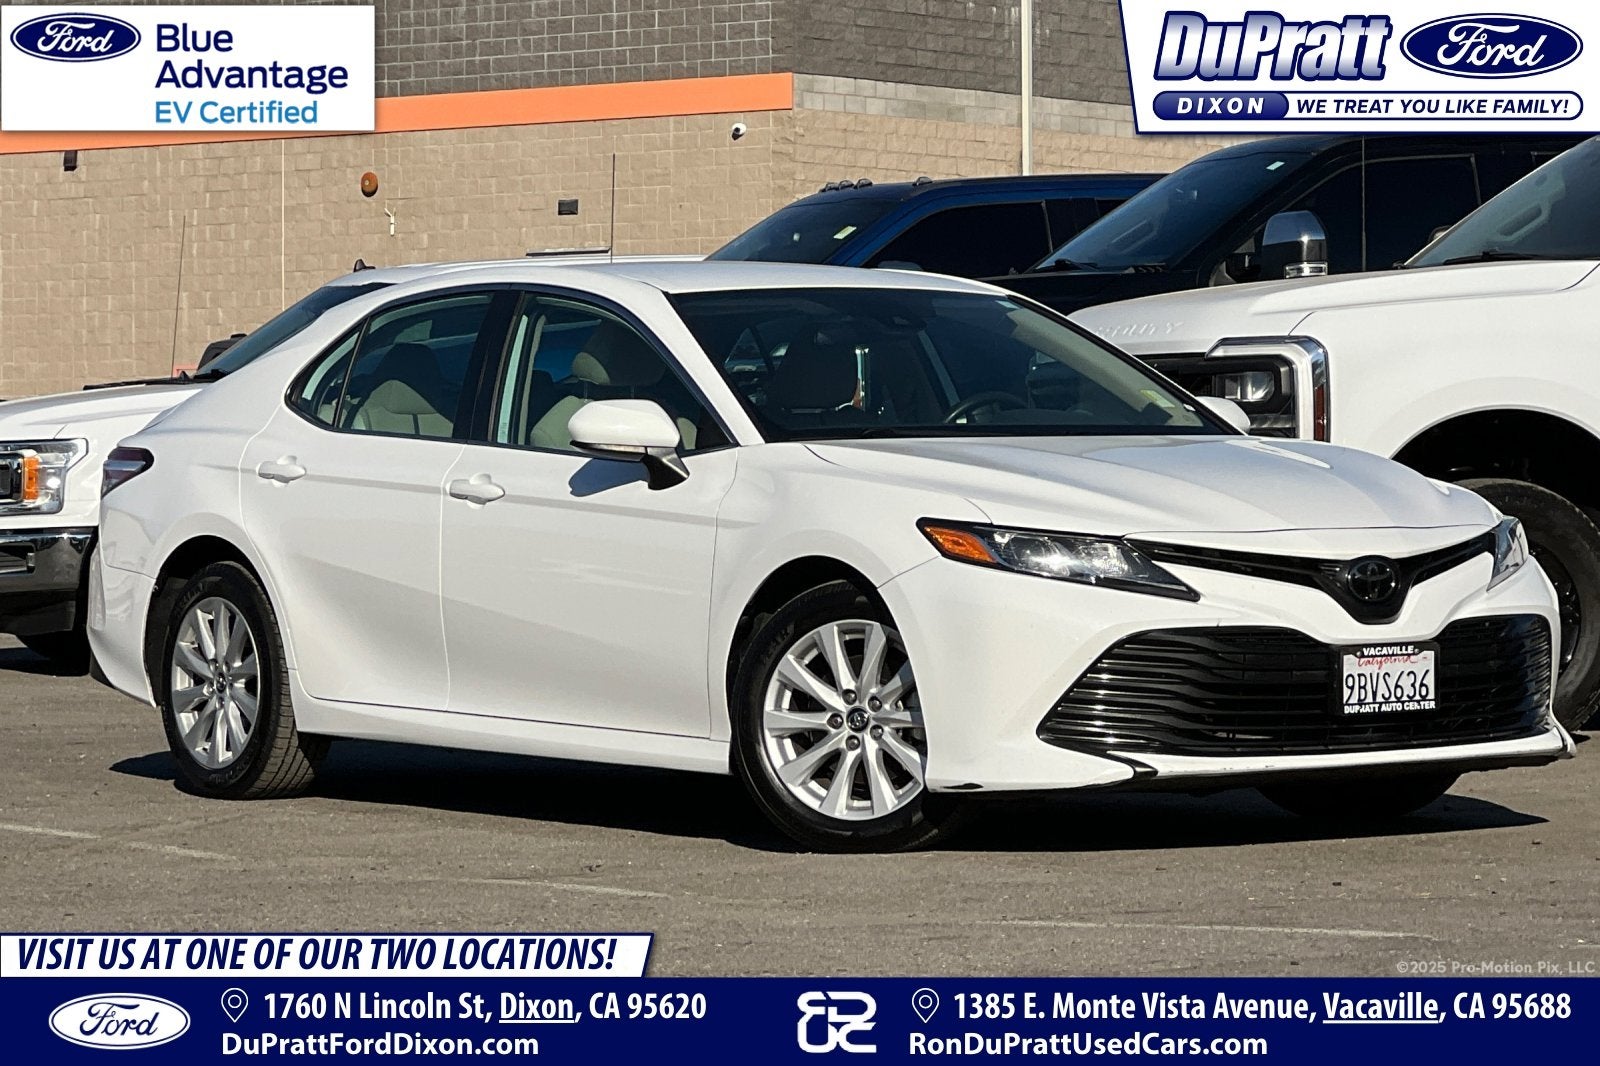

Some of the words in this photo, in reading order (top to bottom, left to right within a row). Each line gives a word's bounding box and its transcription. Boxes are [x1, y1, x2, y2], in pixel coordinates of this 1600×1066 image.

[1363, 646, 1414, 656] VACAVILLE
[1345, 669, 1430, 704] 9BVS636
[1380, 702, 1403, 712] AUTO
[1403, 700, 1436, 711] CENTER
